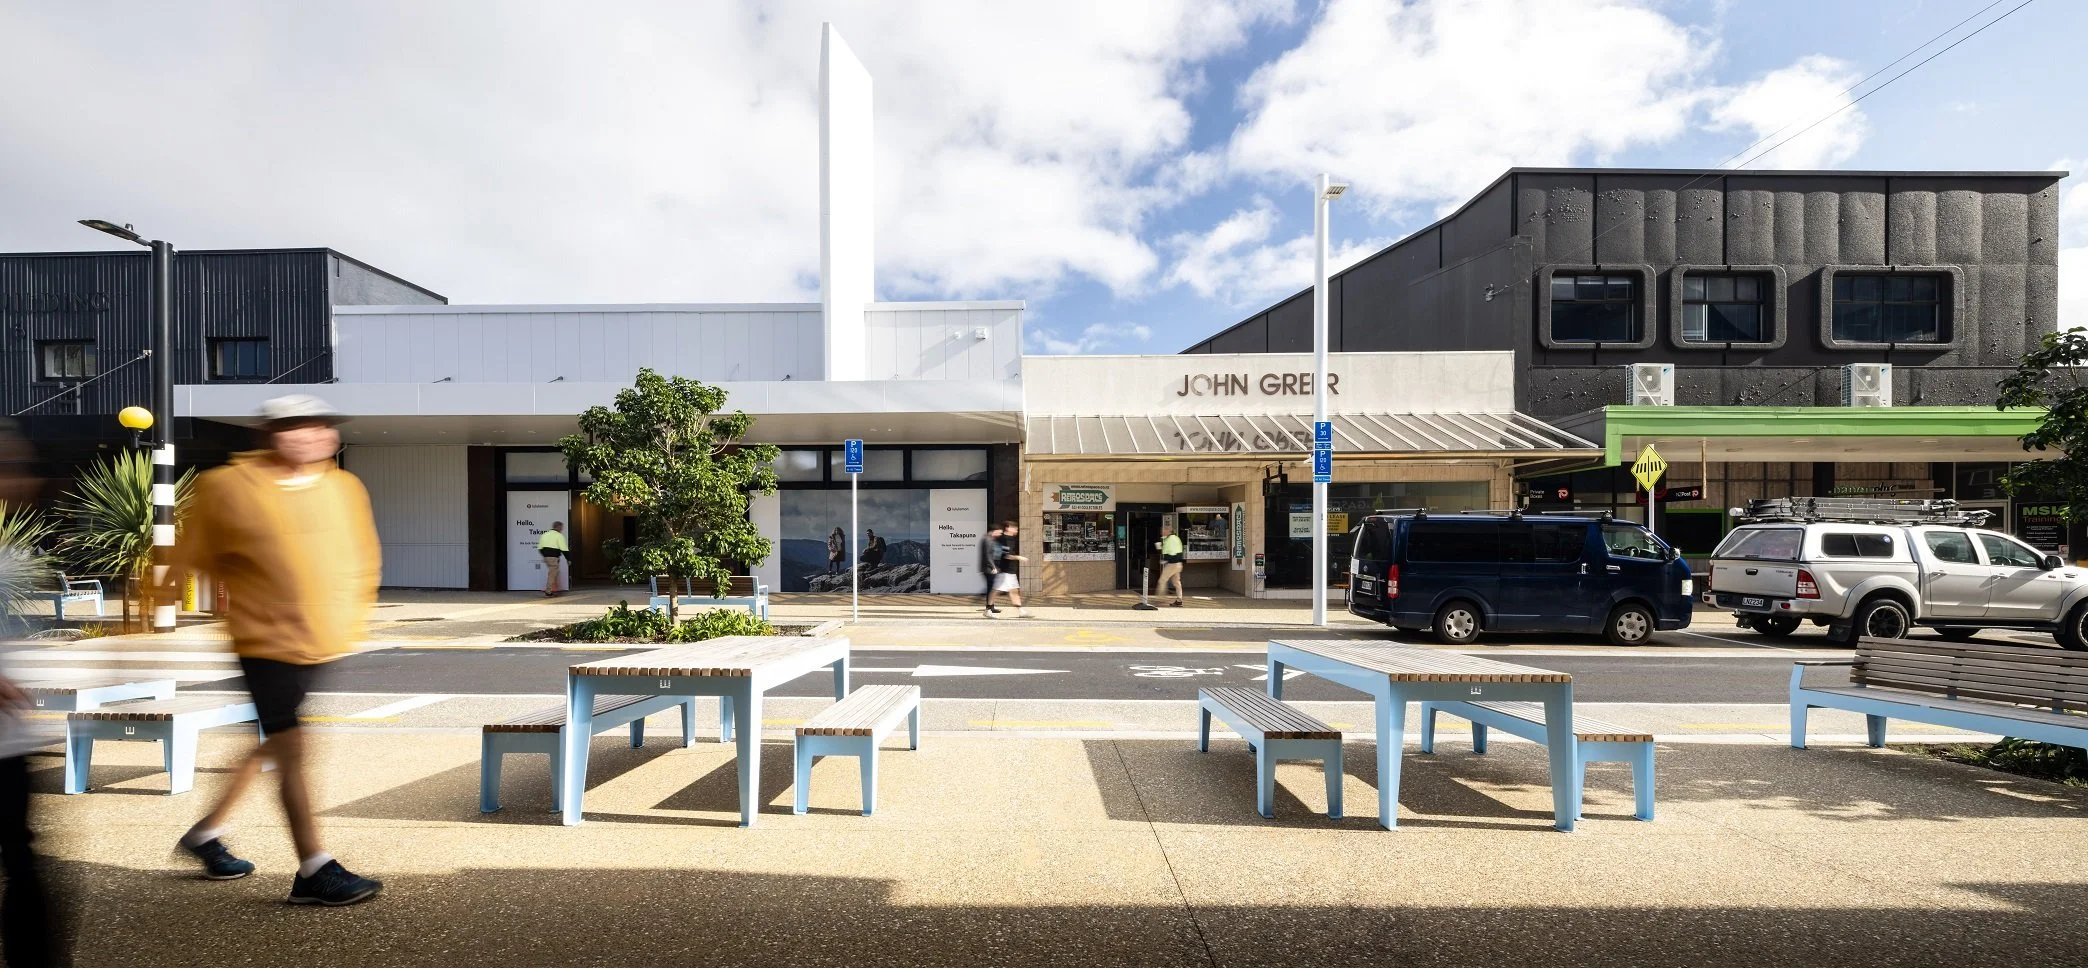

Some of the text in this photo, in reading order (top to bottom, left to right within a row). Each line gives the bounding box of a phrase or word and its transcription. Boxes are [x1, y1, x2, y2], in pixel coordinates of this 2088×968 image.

[1177, 373, 1340, 397] JOHN GRER
[1061, 492, 1103, 503] RETROSPACE
[184, 571, 193, 605] Recycling
